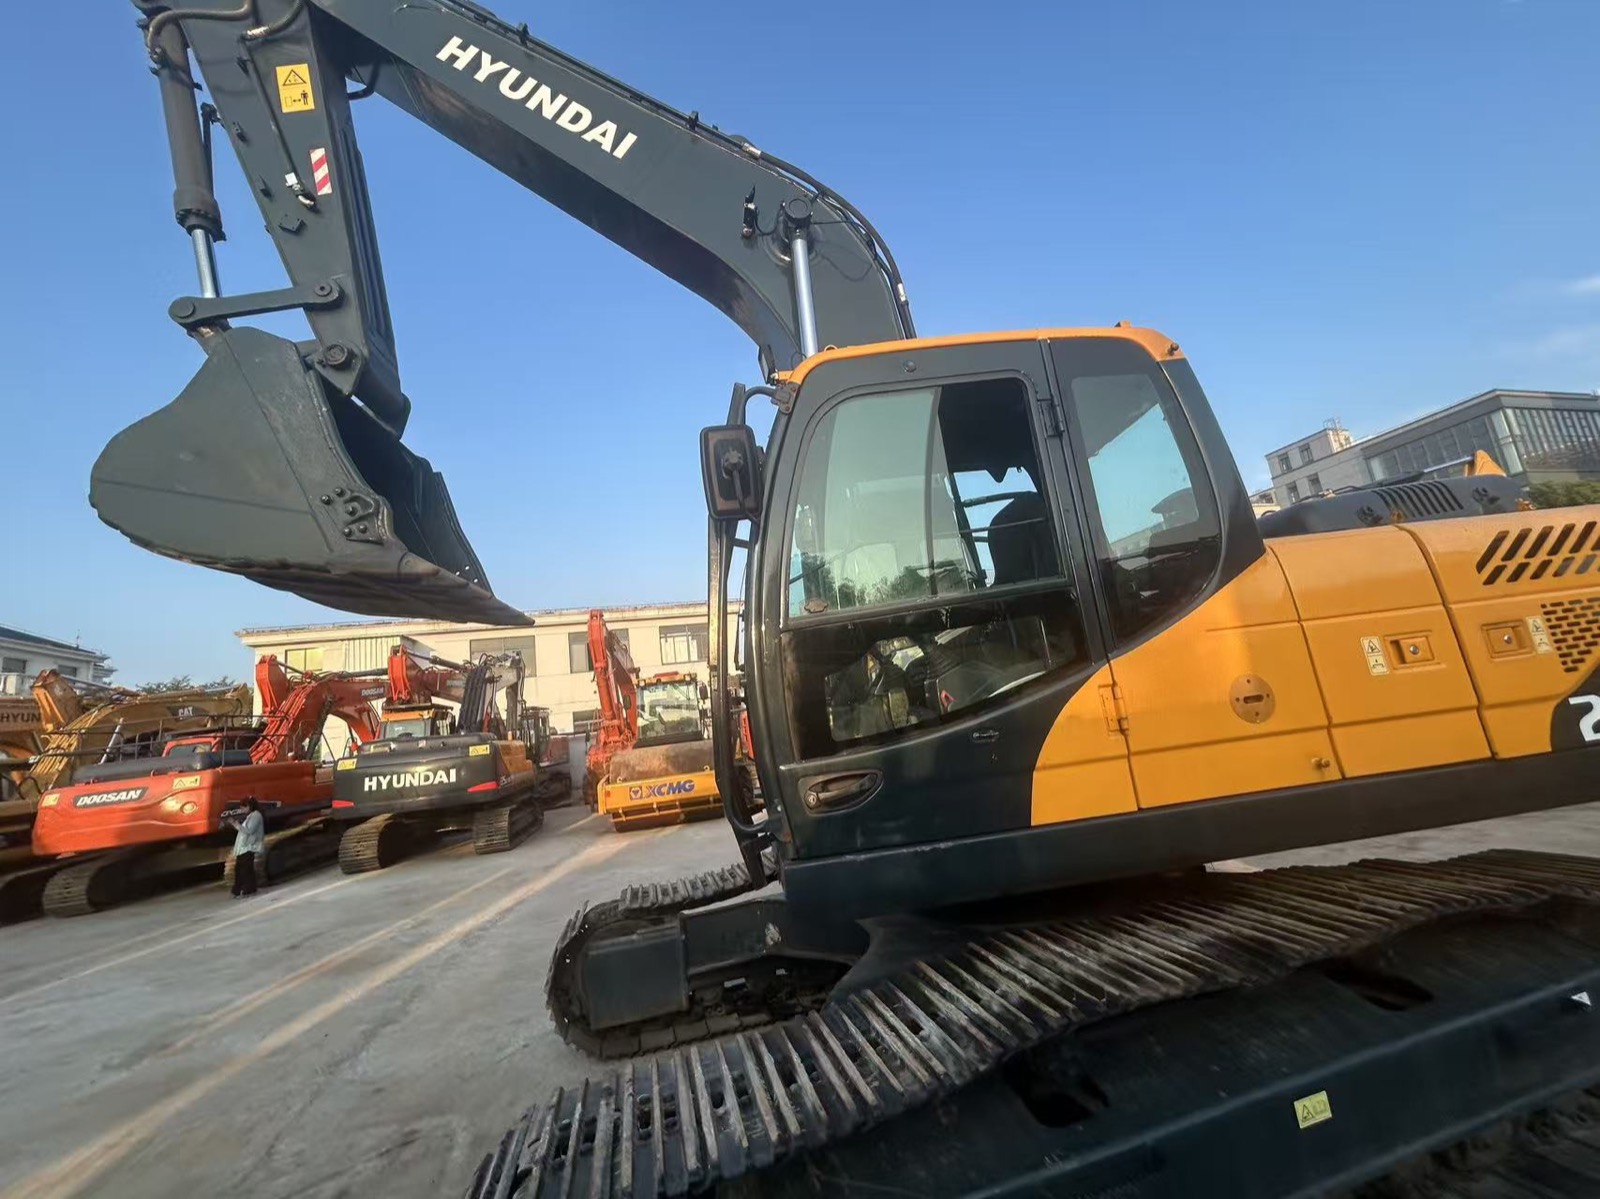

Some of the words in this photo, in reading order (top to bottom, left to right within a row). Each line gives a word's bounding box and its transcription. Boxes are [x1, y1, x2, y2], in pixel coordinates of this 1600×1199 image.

[435, 35, 638, 160] HYUNDAI
[178, 706, 194, 718] CAT
[363, 768, 457, 792] HYUNDAI
[643, 779, 695, 799] XCMG
[76, 788, 142, 807] DOOSAN
